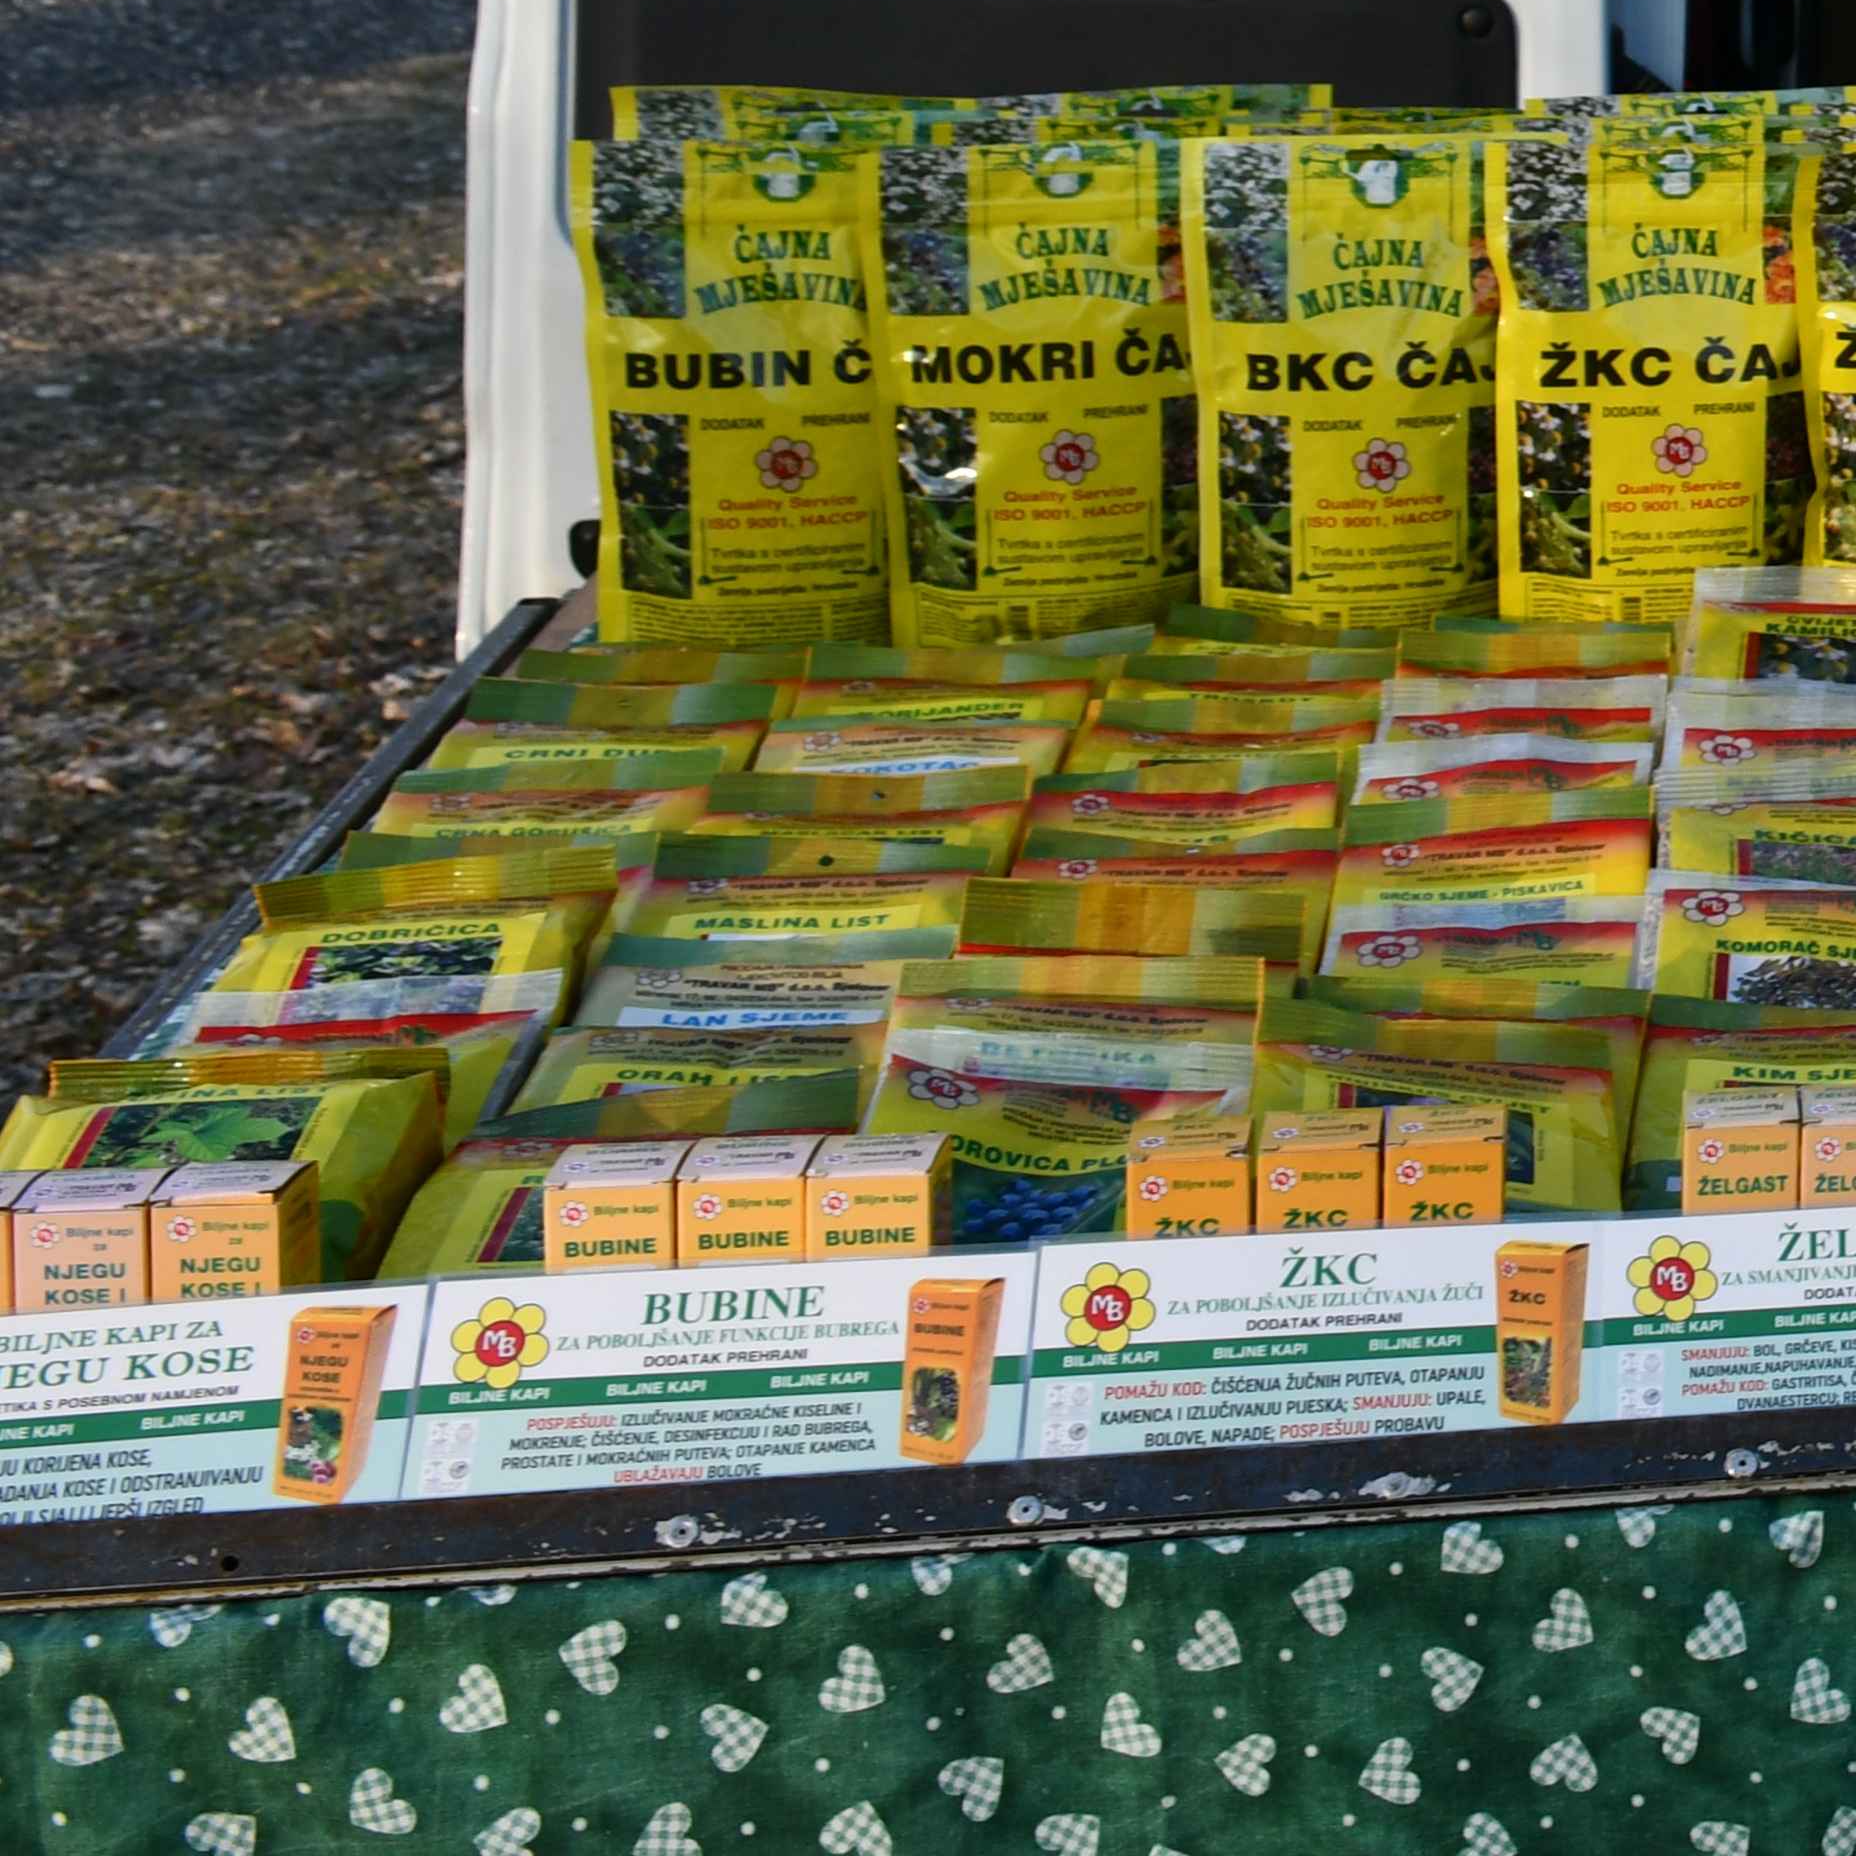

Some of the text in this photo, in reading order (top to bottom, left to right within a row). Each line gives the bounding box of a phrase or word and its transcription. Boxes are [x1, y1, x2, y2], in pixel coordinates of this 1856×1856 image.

[1017, 224, 1110, 259] ČAJNA
[1630, 221, 1718, 258] ČAJNA
[979, 259, 1152, 310] MJEŠAVINA
[1599, 258, 1757, 308] MJEŠAVINA
[625, 349, 811, 389] BUBIN
[911, 340, 1096, 383] MOKRI
[1248, 351, 1372, 390] BKC
[321, 922, 501, 945] DOBRIČICA
[694, 912, 890, 931] MASLINA LIST
[1716, 936, 1820, 956] KOMORAČ
[661, 1011, 847, 1026] LAN SJEME
[1733, 1065, 1781, 1080] KIM
[1696, 1171, 1789, 1198] ŽELGAST
[564, 1235, 657, 1257] BUBINE
[180, 1253, 261, 1275] NJEGU
[1280, 1246, 1379, 1287] ŽKC
[1722, 1272, 1743, 1286] ZA
[642, 1286, 826, 1327] BUBINE
[1167, 1282, 1484, 1315] ZA POBOLJŠANJE IZLUČIVANJA ŽUČI
[558, 1320, 900, 1352] ZA POBOLJŠANJE FUNKCIJE BUBREGA
[125, 1345, 254, 1378] KOSE
[606, 1378, 707, 1397] BILJNE KAPI
[1104, 1365, 1485, 1399] POMAŽU KOD: ČIŠĆENJA ŽUČNIH PUTEVA, OTAPANJU
[613, 1462, 762, 1484] UBLAŽAVAJU BOLOVE
